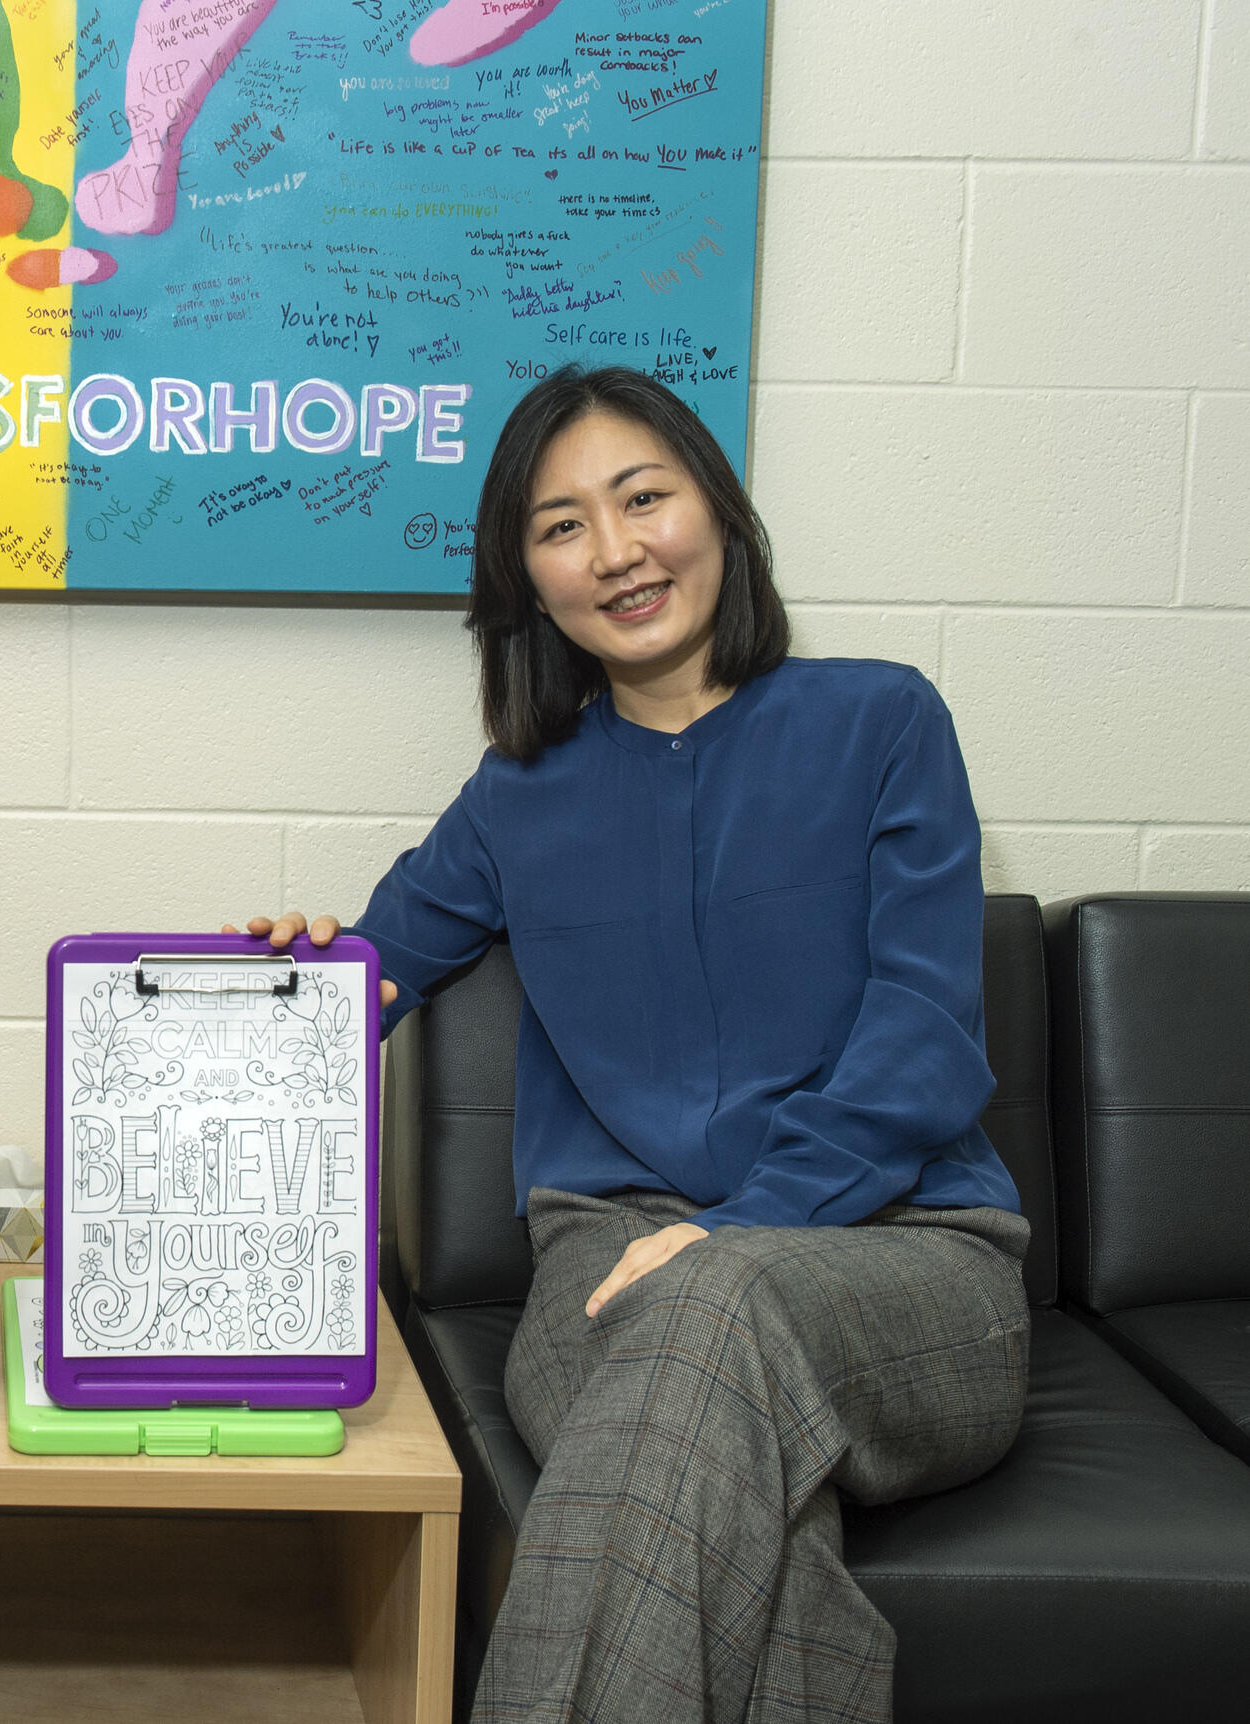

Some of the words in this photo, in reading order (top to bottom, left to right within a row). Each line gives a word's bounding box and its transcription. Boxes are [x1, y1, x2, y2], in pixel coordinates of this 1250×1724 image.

[575, 32, 610, 43] Minor
[575, 47, 611, 56] result
[619, 48, 631, 57] in
[639, 48, 685, 61] major
[512, 66, 532, 79] are
[536, 58, 573, 78] worth
[138, 58, 191, 100] KEEP
[504, 80, 522, 98] it!
[618, 90, 648, 114] You
[121, 121, 183, 158] THE
[383, 142, 395, 154] is
[433, 146, 443, 155] a
[577, 146, 595, 160] all
[602, 151, 619, 160] on
[625, 148, 649, 162] how
[558, 194, 582, 204] there
[588, 193, 595, 203] is
[599, 195, 609, 203] no
[415, 202, 498, 219] EVERYTHING!
[566, 208, 588, 216] take
[595, 208, 616, 220] your
[622, 208, 647, 217] time
[304, 263, 315, 273] is
[394, 271, 417, 281] you
[423, 268, 462, 290] doing
[344, 278, 358, 295] to
[367, 283, 397, 303] help
[82, 307, 103, 318] will
[109, 305, 148, 322] always
[281, 301, 338, 330] You're
[345, 310, 378, 329] not
[30, 326, 55, 338] care
[60, 323, 94, 338] about
[545, 323, 587, 345] Self
[589, 331, 628, 346] care
[635, 332, 650, 346] is
[506, 360, 548, 379] Yolo
[656, 353, 697, 368] LIVE,
[702, 366, 739, 381] LOVE
[298, 476, 329, 500] Don't
[334, 466, 352, 483] put
[207, 508, 230, 528] not
[231, 500, 247, 514] be
[304, 501, 321, 512] to
[314, 514, 331, 526] on
[161, 971, 276, 1011] KEEP
[150, 1019, 279, 1060] CALM
[193, 1068, 241, 1088] AND
